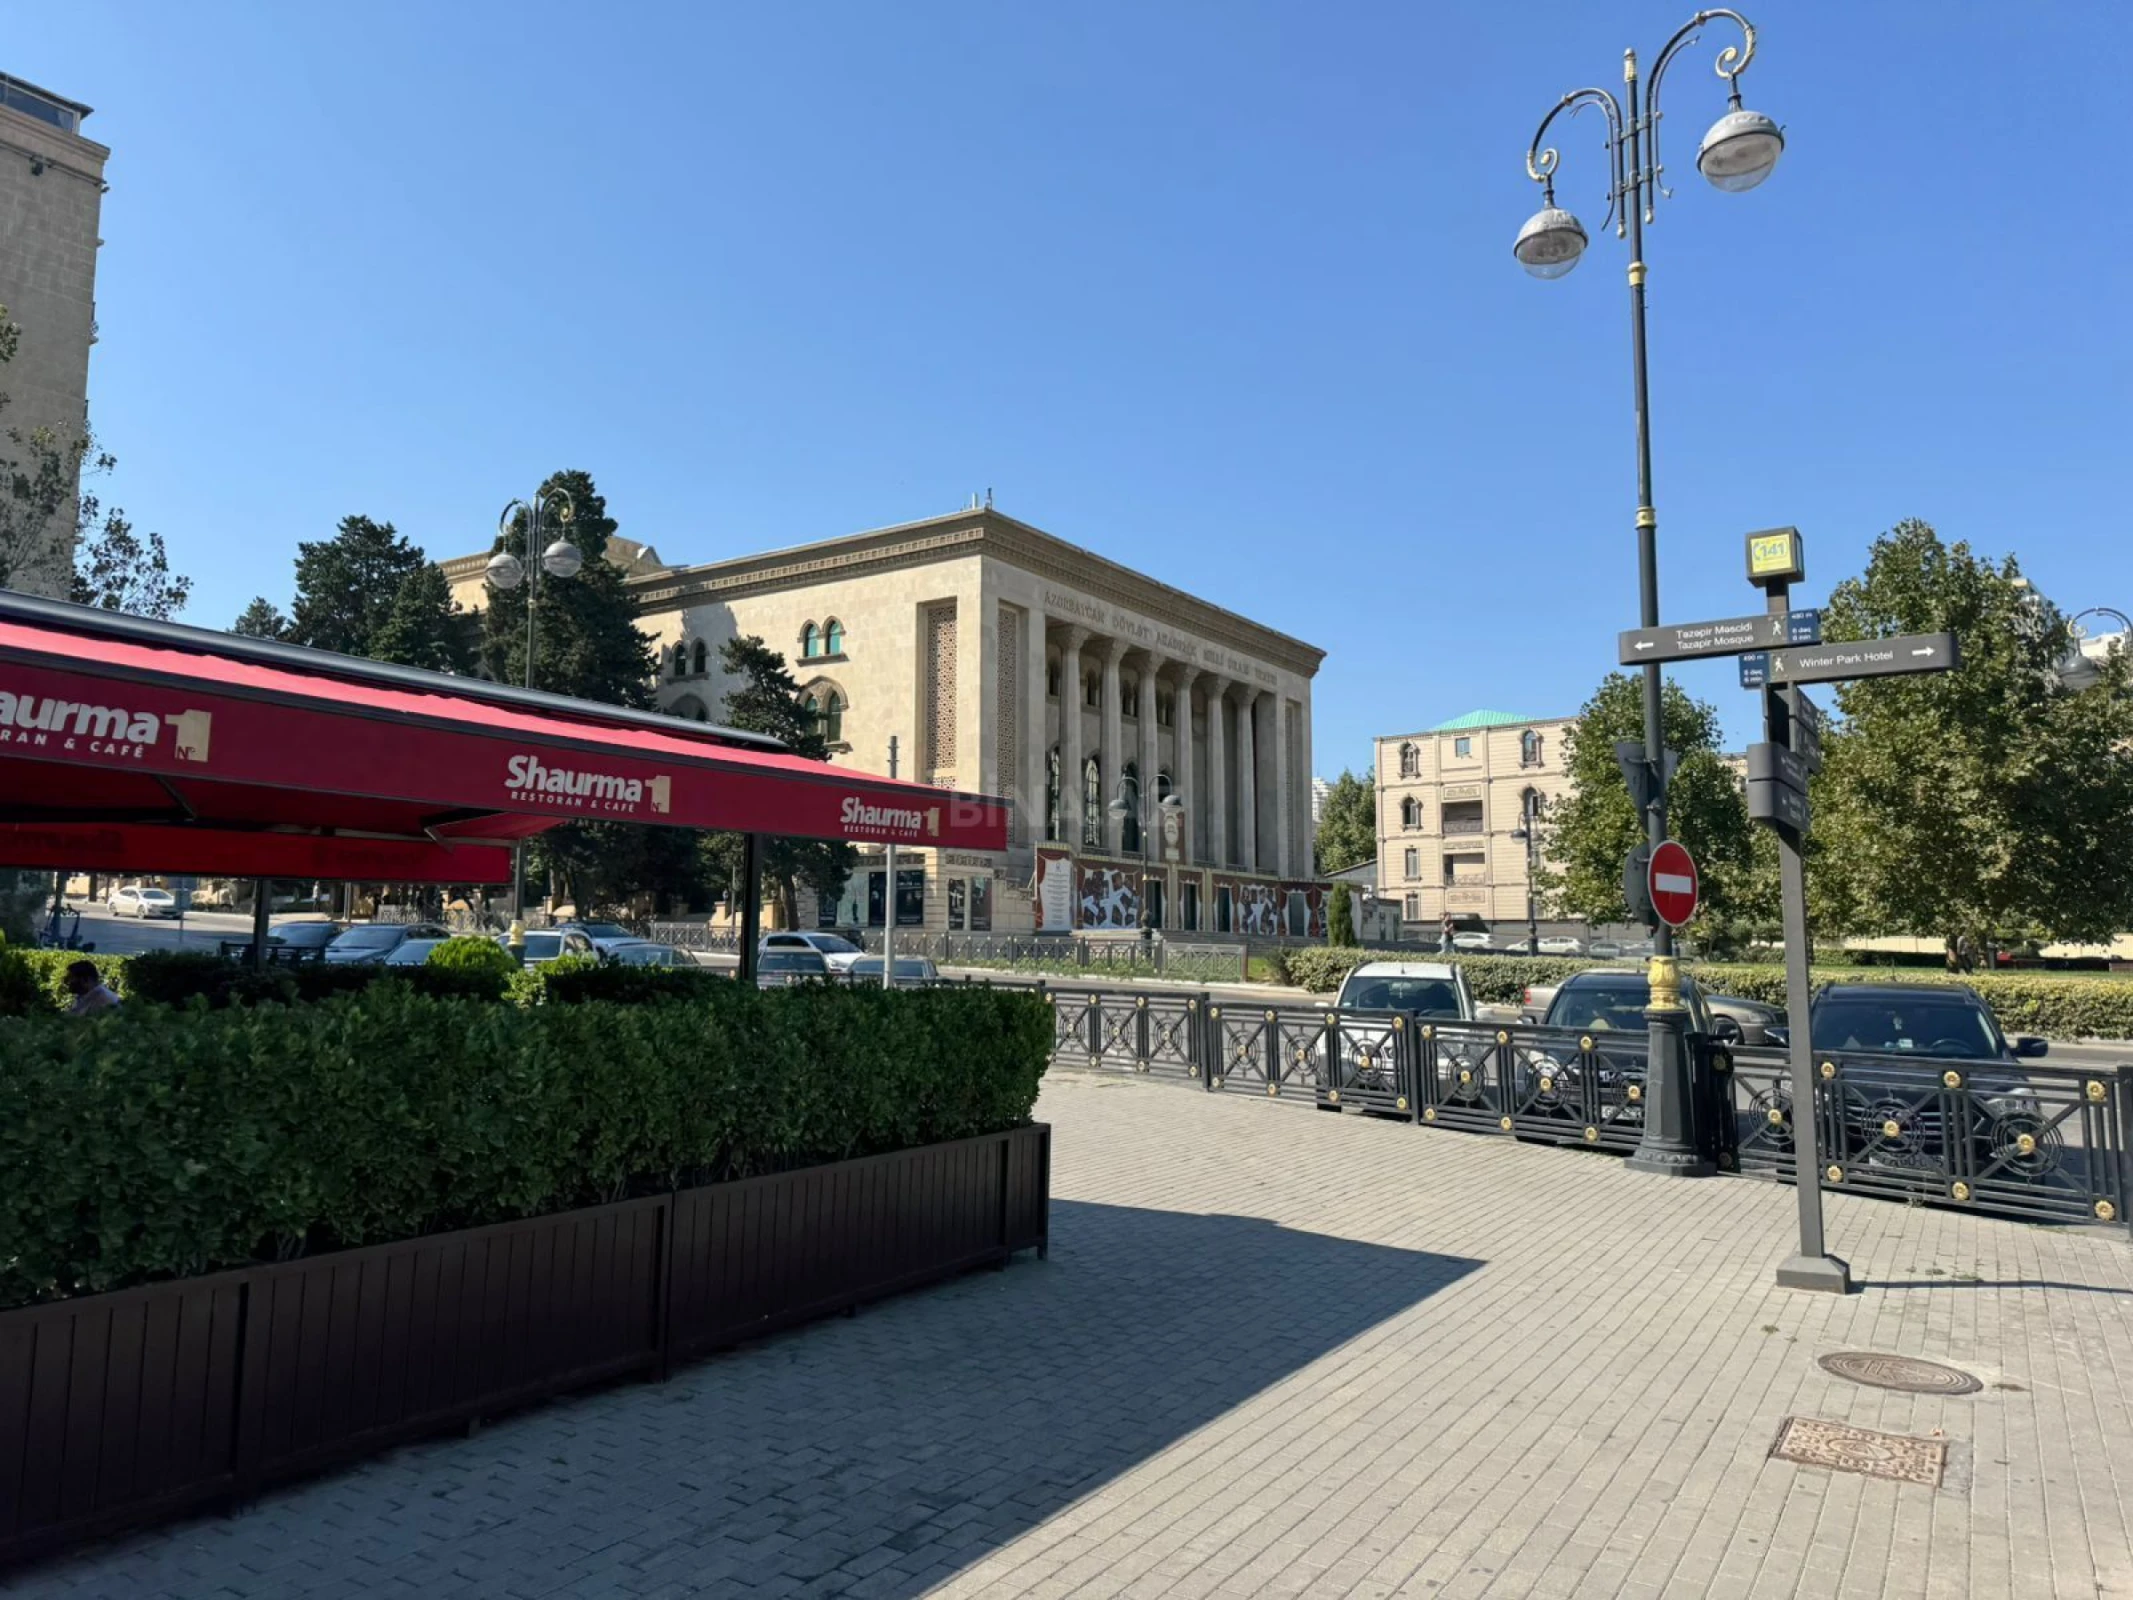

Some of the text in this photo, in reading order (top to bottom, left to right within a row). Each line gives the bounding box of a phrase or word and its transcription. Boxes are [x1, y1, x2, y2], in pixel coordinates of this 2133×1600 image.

[1714, 634, 1754, 646] Mosque
[1799, 649, 1894, 669] Winter Park Hotel
[64, 737, 76, 750] &
[90, 741, 145, 758] CAFÉ
[504, 755, 672, 814] Shaurma 1
[511, 791, 635, 813] RESTORAN & CAFÉ
[840, 796, 940, 837] Shaurma 1
